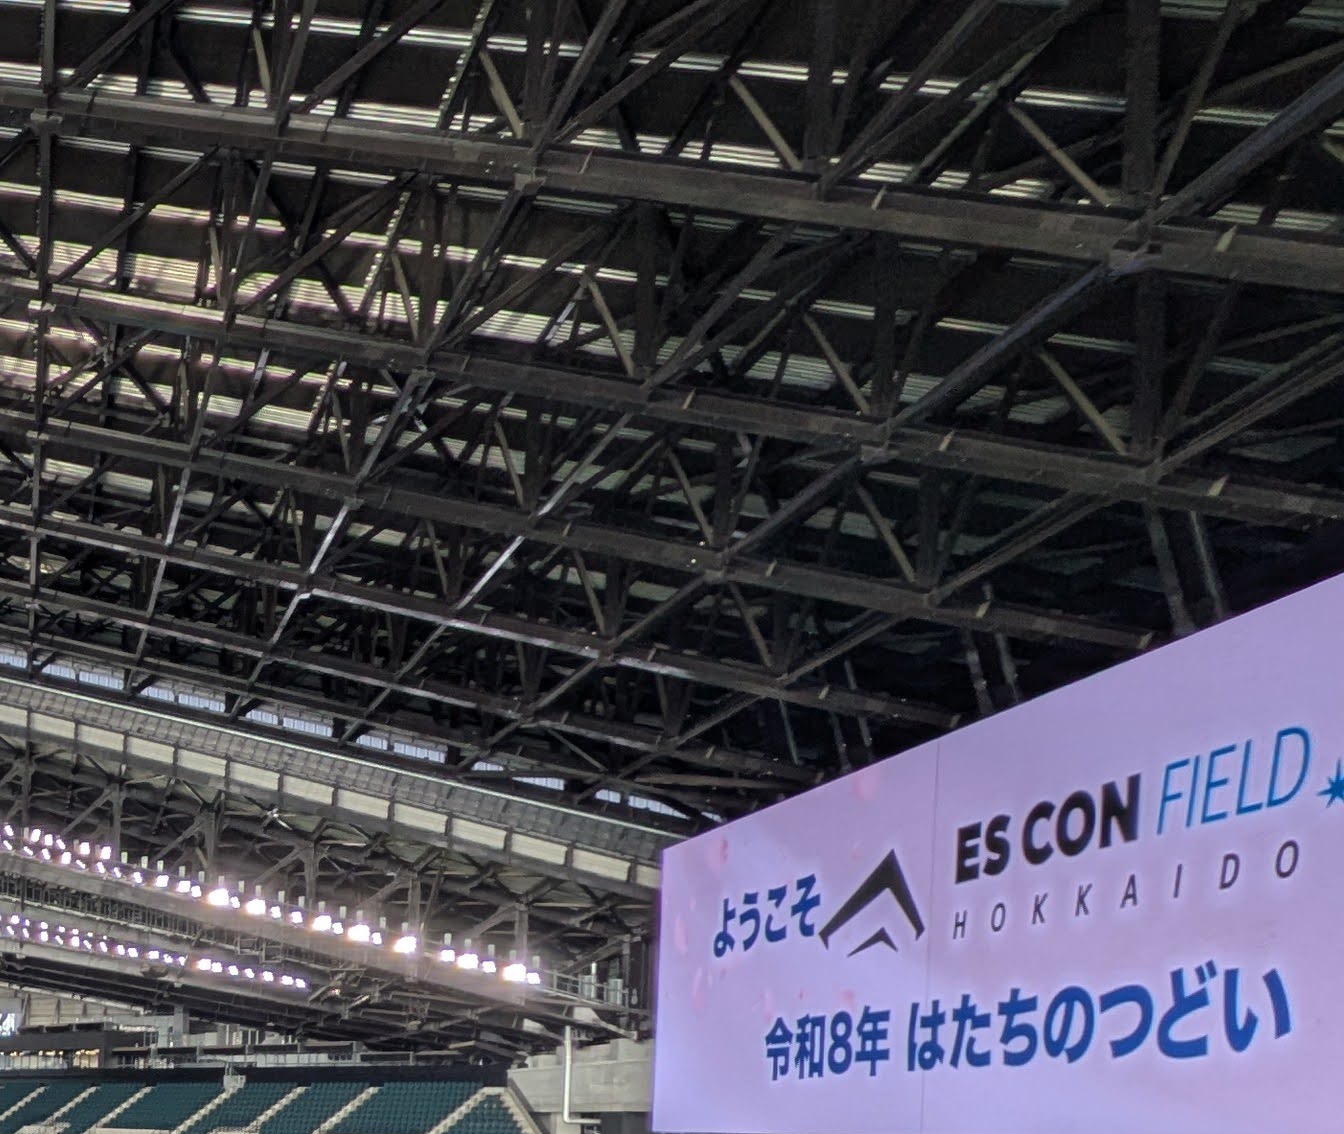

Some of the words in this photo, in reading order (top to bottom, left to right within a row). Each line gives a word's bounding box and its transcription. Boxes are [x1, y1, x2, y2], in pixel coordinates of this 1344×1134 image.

[1157, 726, 1310, 836] FIELD
[713, 874, 822, 959] ようこそ
[952, 839, 1299, 940] HOKKAIDO
[765, 1006, 891, 1083] 令和8年
[907, 960, 1292, 1071] はたちのつどい
